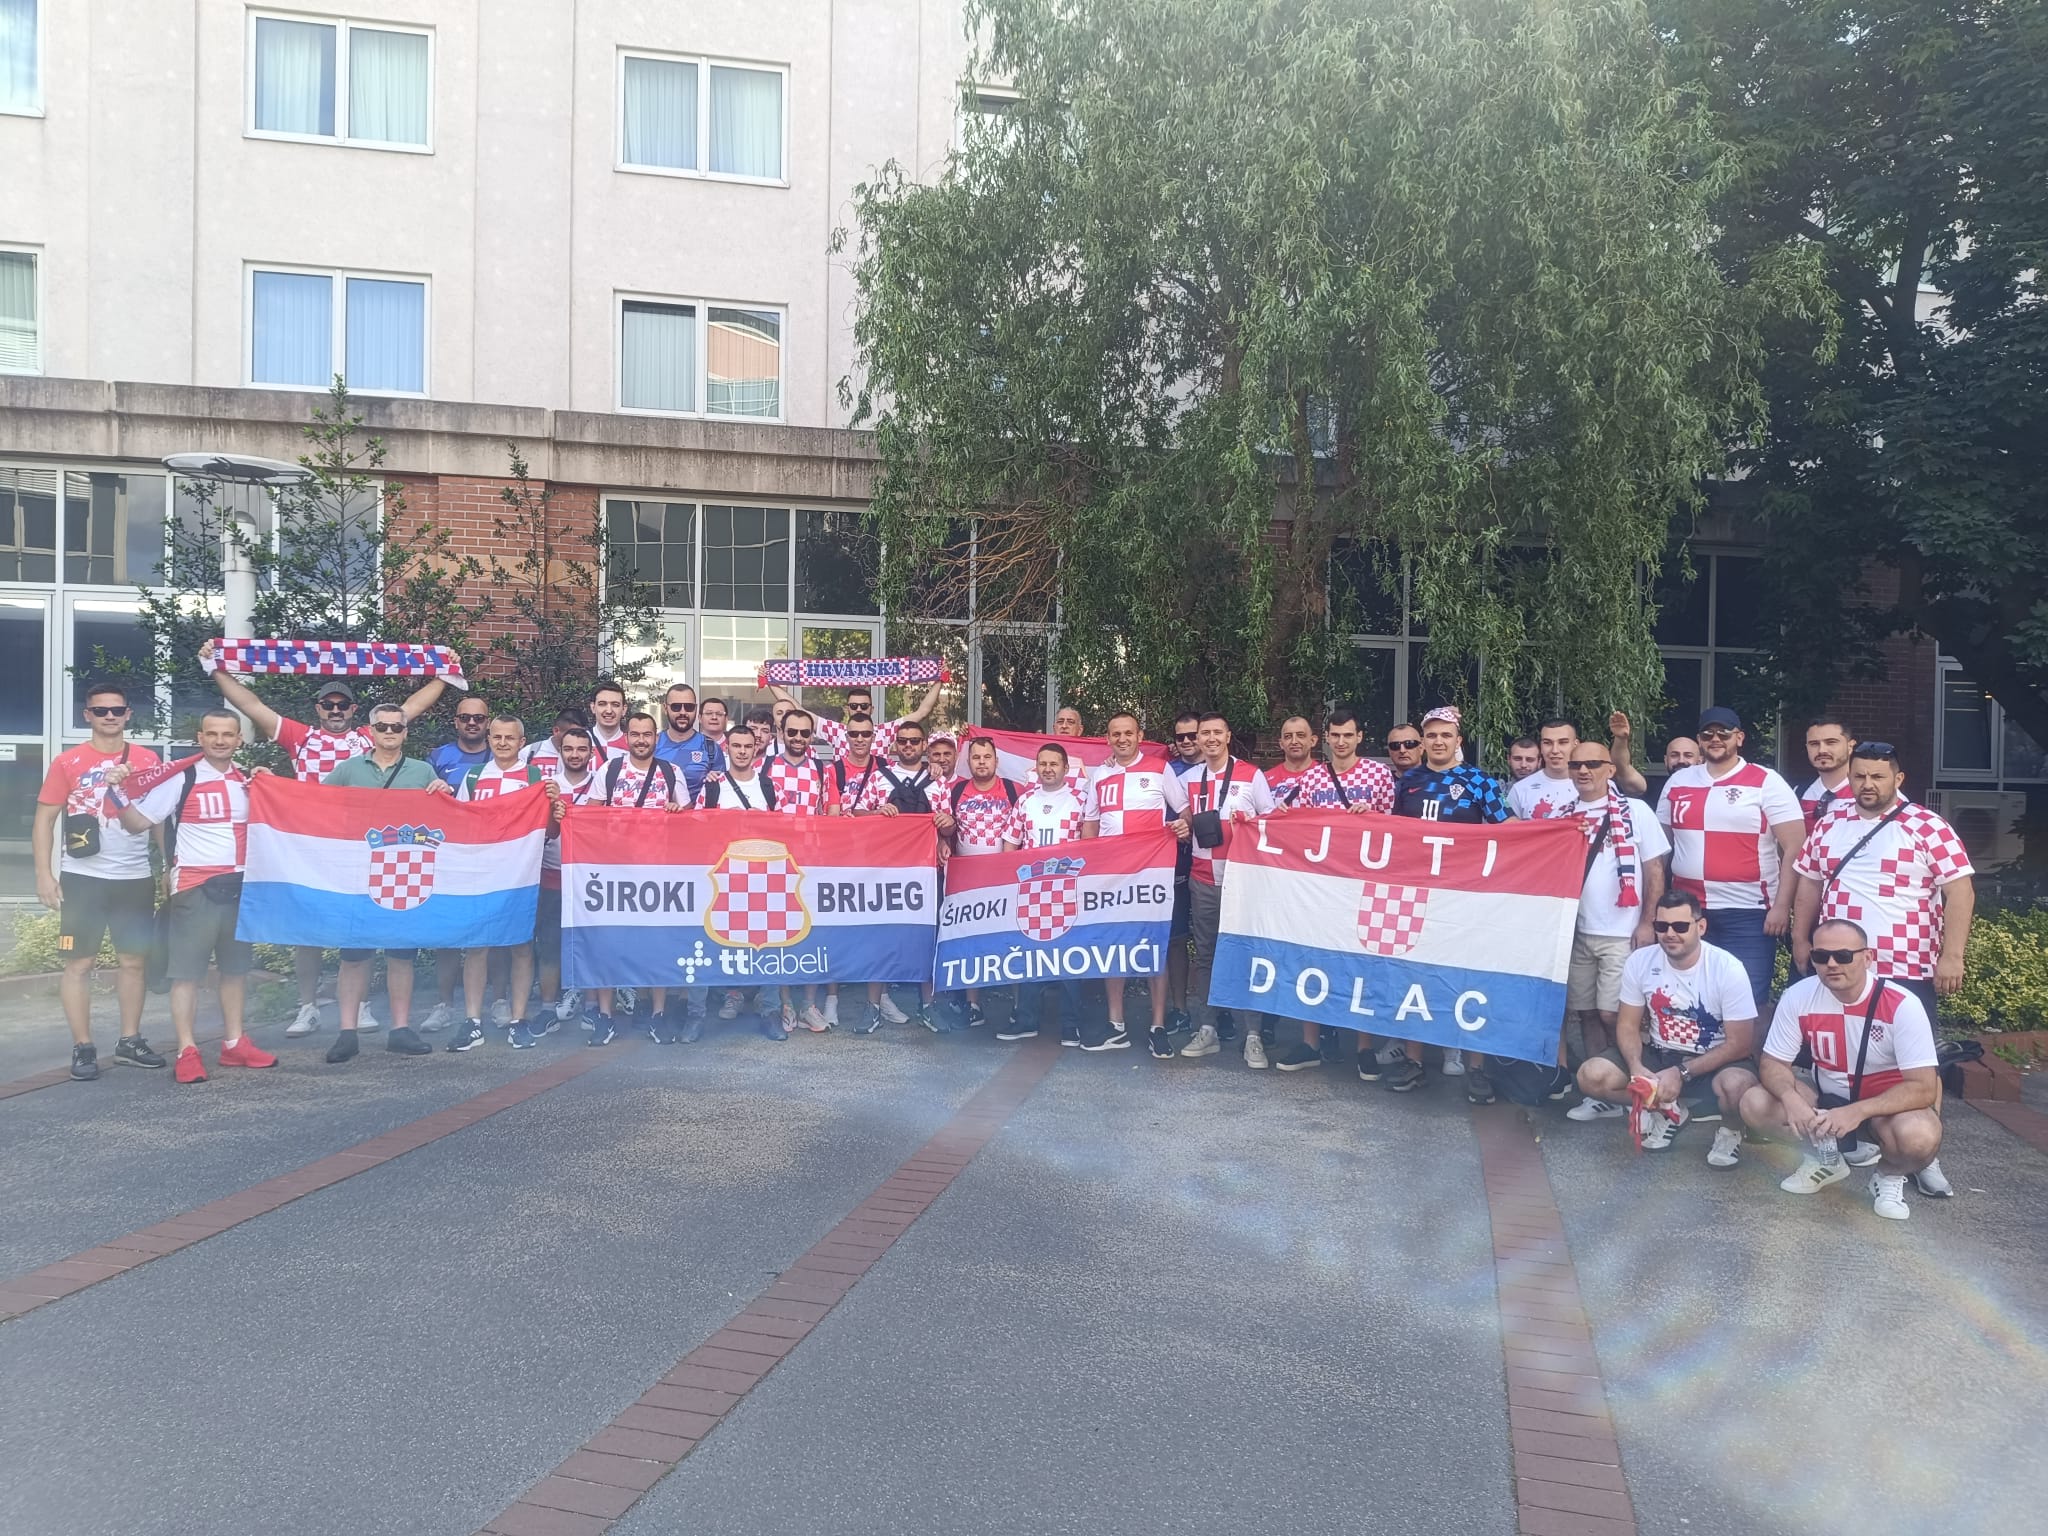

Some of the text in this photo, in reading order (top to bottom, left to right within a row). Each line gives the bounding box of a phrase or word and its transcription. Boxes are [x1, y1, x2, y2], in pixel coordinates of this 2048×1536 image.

[245, 645, 445, 669] HRVATSKA
[806, 662, 900, 677] HRVATSKA
[196, 792, 225, 819] 10
[1101, 784, 1119, 807] 10
[1420, 799, 1440, 822] 10
[1673, 800, 1692, 824] 17
[1039, 828, 1054, 847] 10
[1257, 819, 1498, 877] LJUTI
[584, 873, 924, 913] ŠIROKI BRIJEG
[942, 884, 1167, 927] ŠIROKI BRIJEG
[719, 946, 829, 976] ttkabeli
[942, 938, 1160, 987] TURČINOVIĆI
[1249, 957, 1488, 1031] DOLAC
[1807, 1030, 1838, 1067] 10
